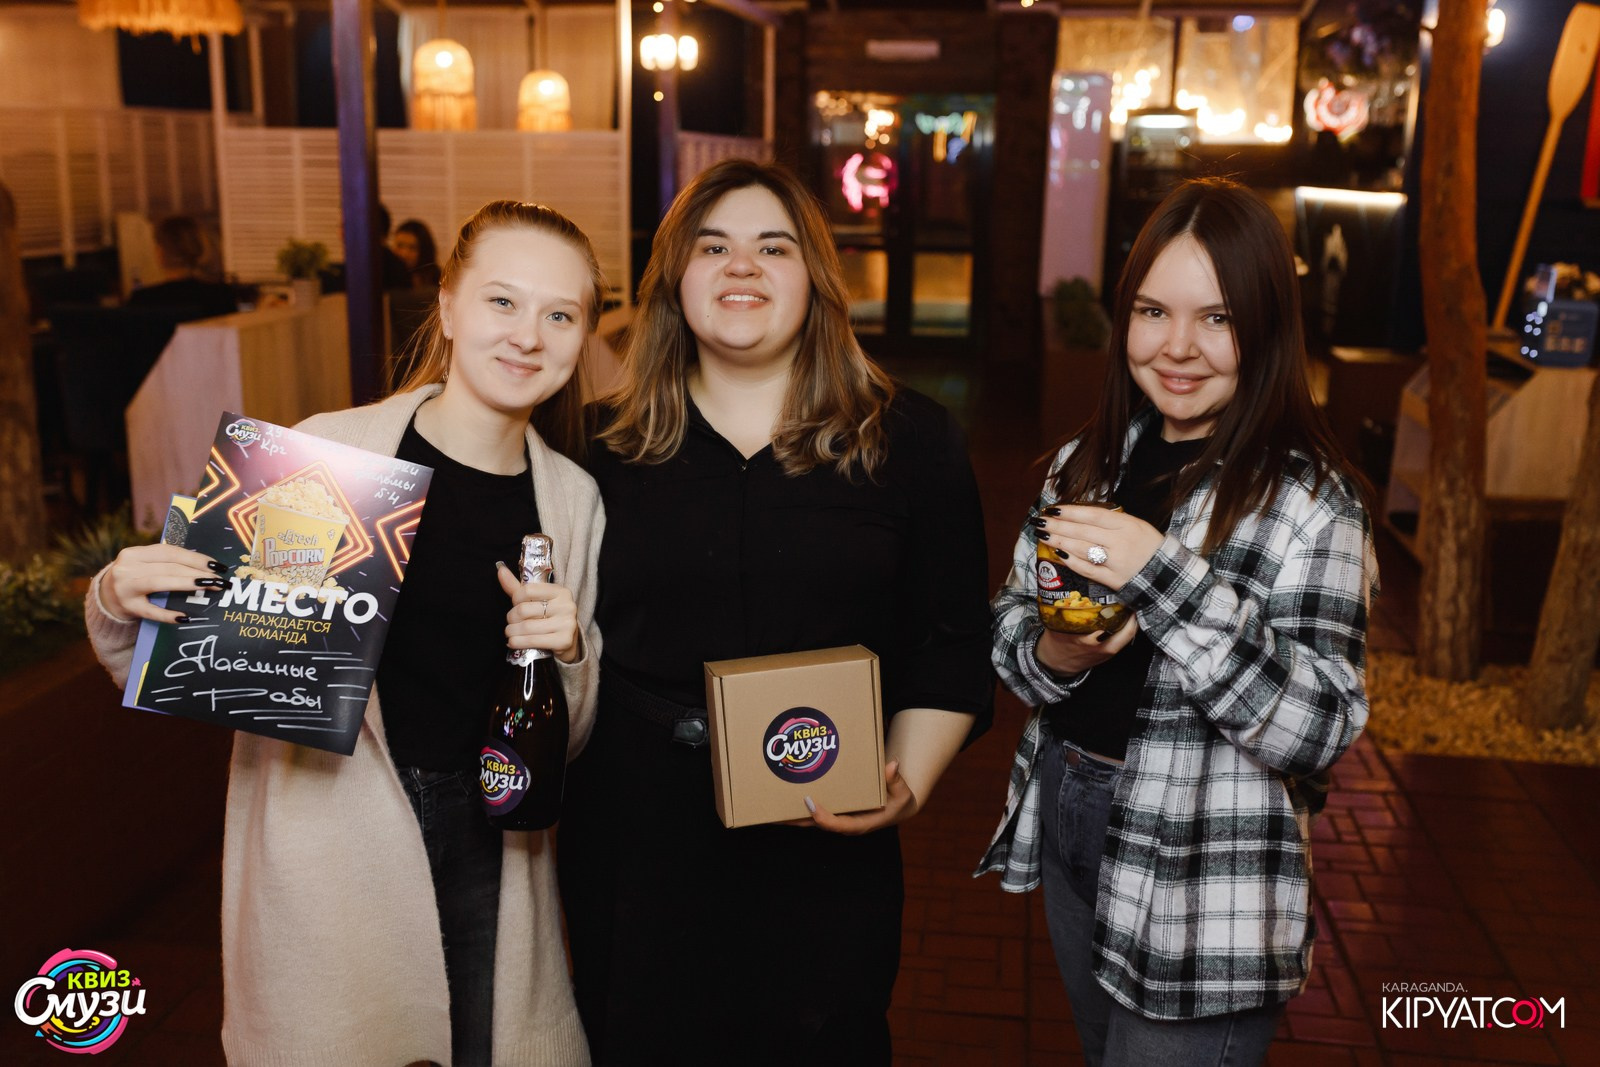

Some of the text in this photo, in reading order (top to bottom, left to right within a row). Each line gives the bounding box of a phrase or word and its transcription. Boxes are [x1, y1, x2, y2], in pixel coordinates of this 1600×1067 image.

[217, 576, 379, 625] МЕСТО
[223, 610, 332, 634] НАГРАЖДАЕТСЯ
[238, 625, 308, 645] КОМАНДА
[793, 726, 827, 740] КВИЗ
[766, 733, 837, 762] Смузи
[480, 763, 524, 791] музи
[486, 759, 516, 775] КВИЗ
